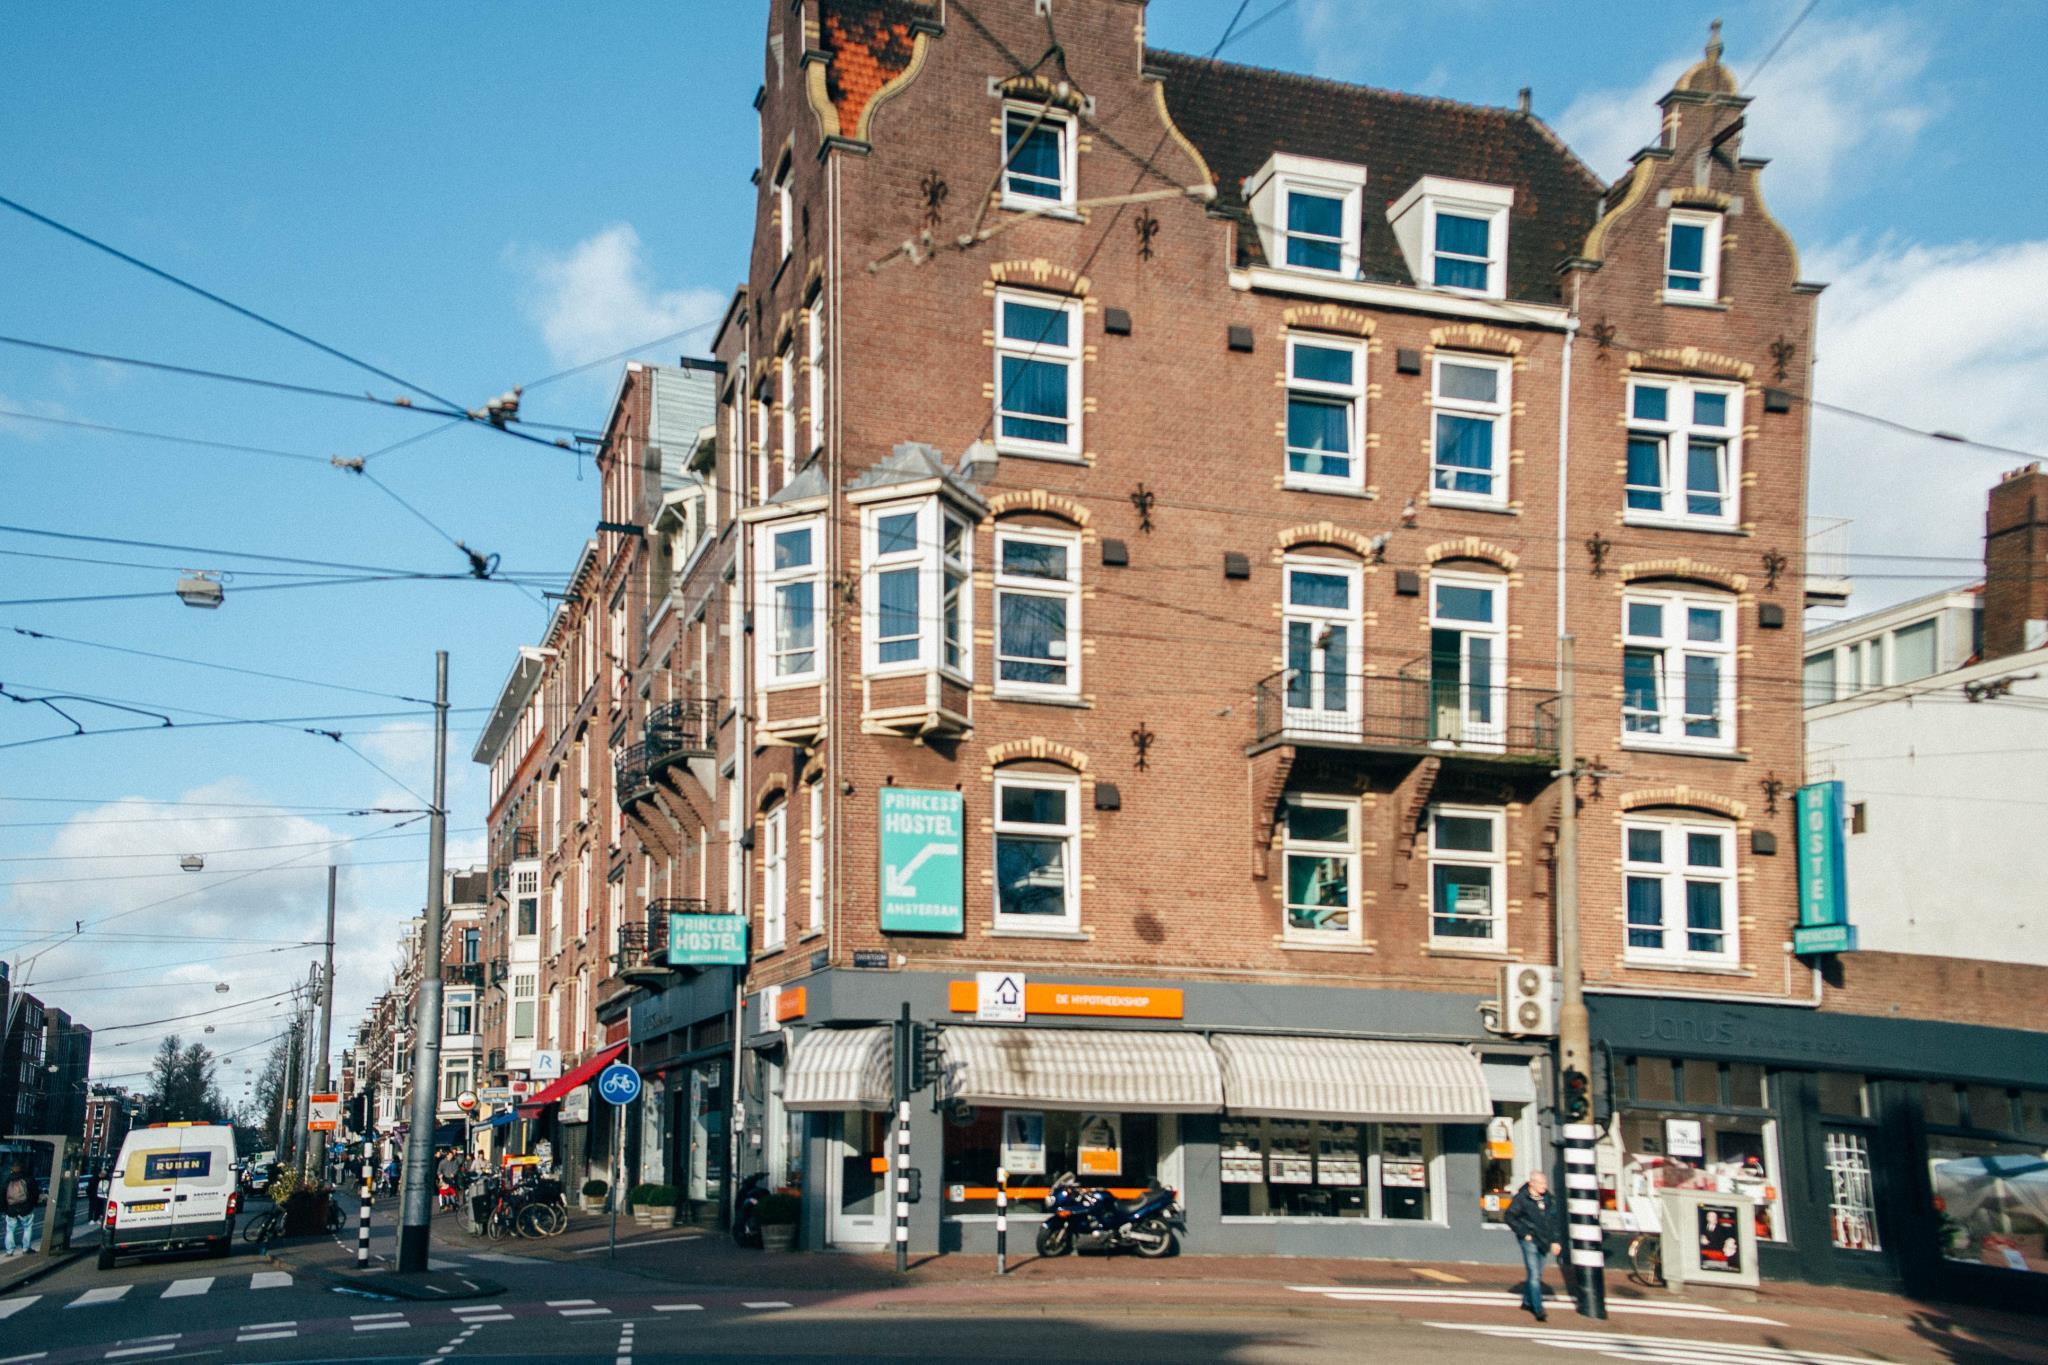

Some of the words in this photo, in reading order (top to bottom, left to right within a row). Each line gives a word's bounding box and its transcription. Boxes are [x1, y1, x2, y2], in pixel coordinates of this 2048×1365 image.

[886, 793, 959, 812] PRINCESS
[886, 812, 958, 836] HOSTEL
[1807, 788, 1826, 923] HOSTEL
[887, 902, 959, 917] AMSTERDAM
[675, 917, 741, 932] PRINCESS
[675, 932, 741, 951] HOSTEL
[1055, 993, 1069, 1005] DE
[156, 1160, 200, 1171] RUBEN
